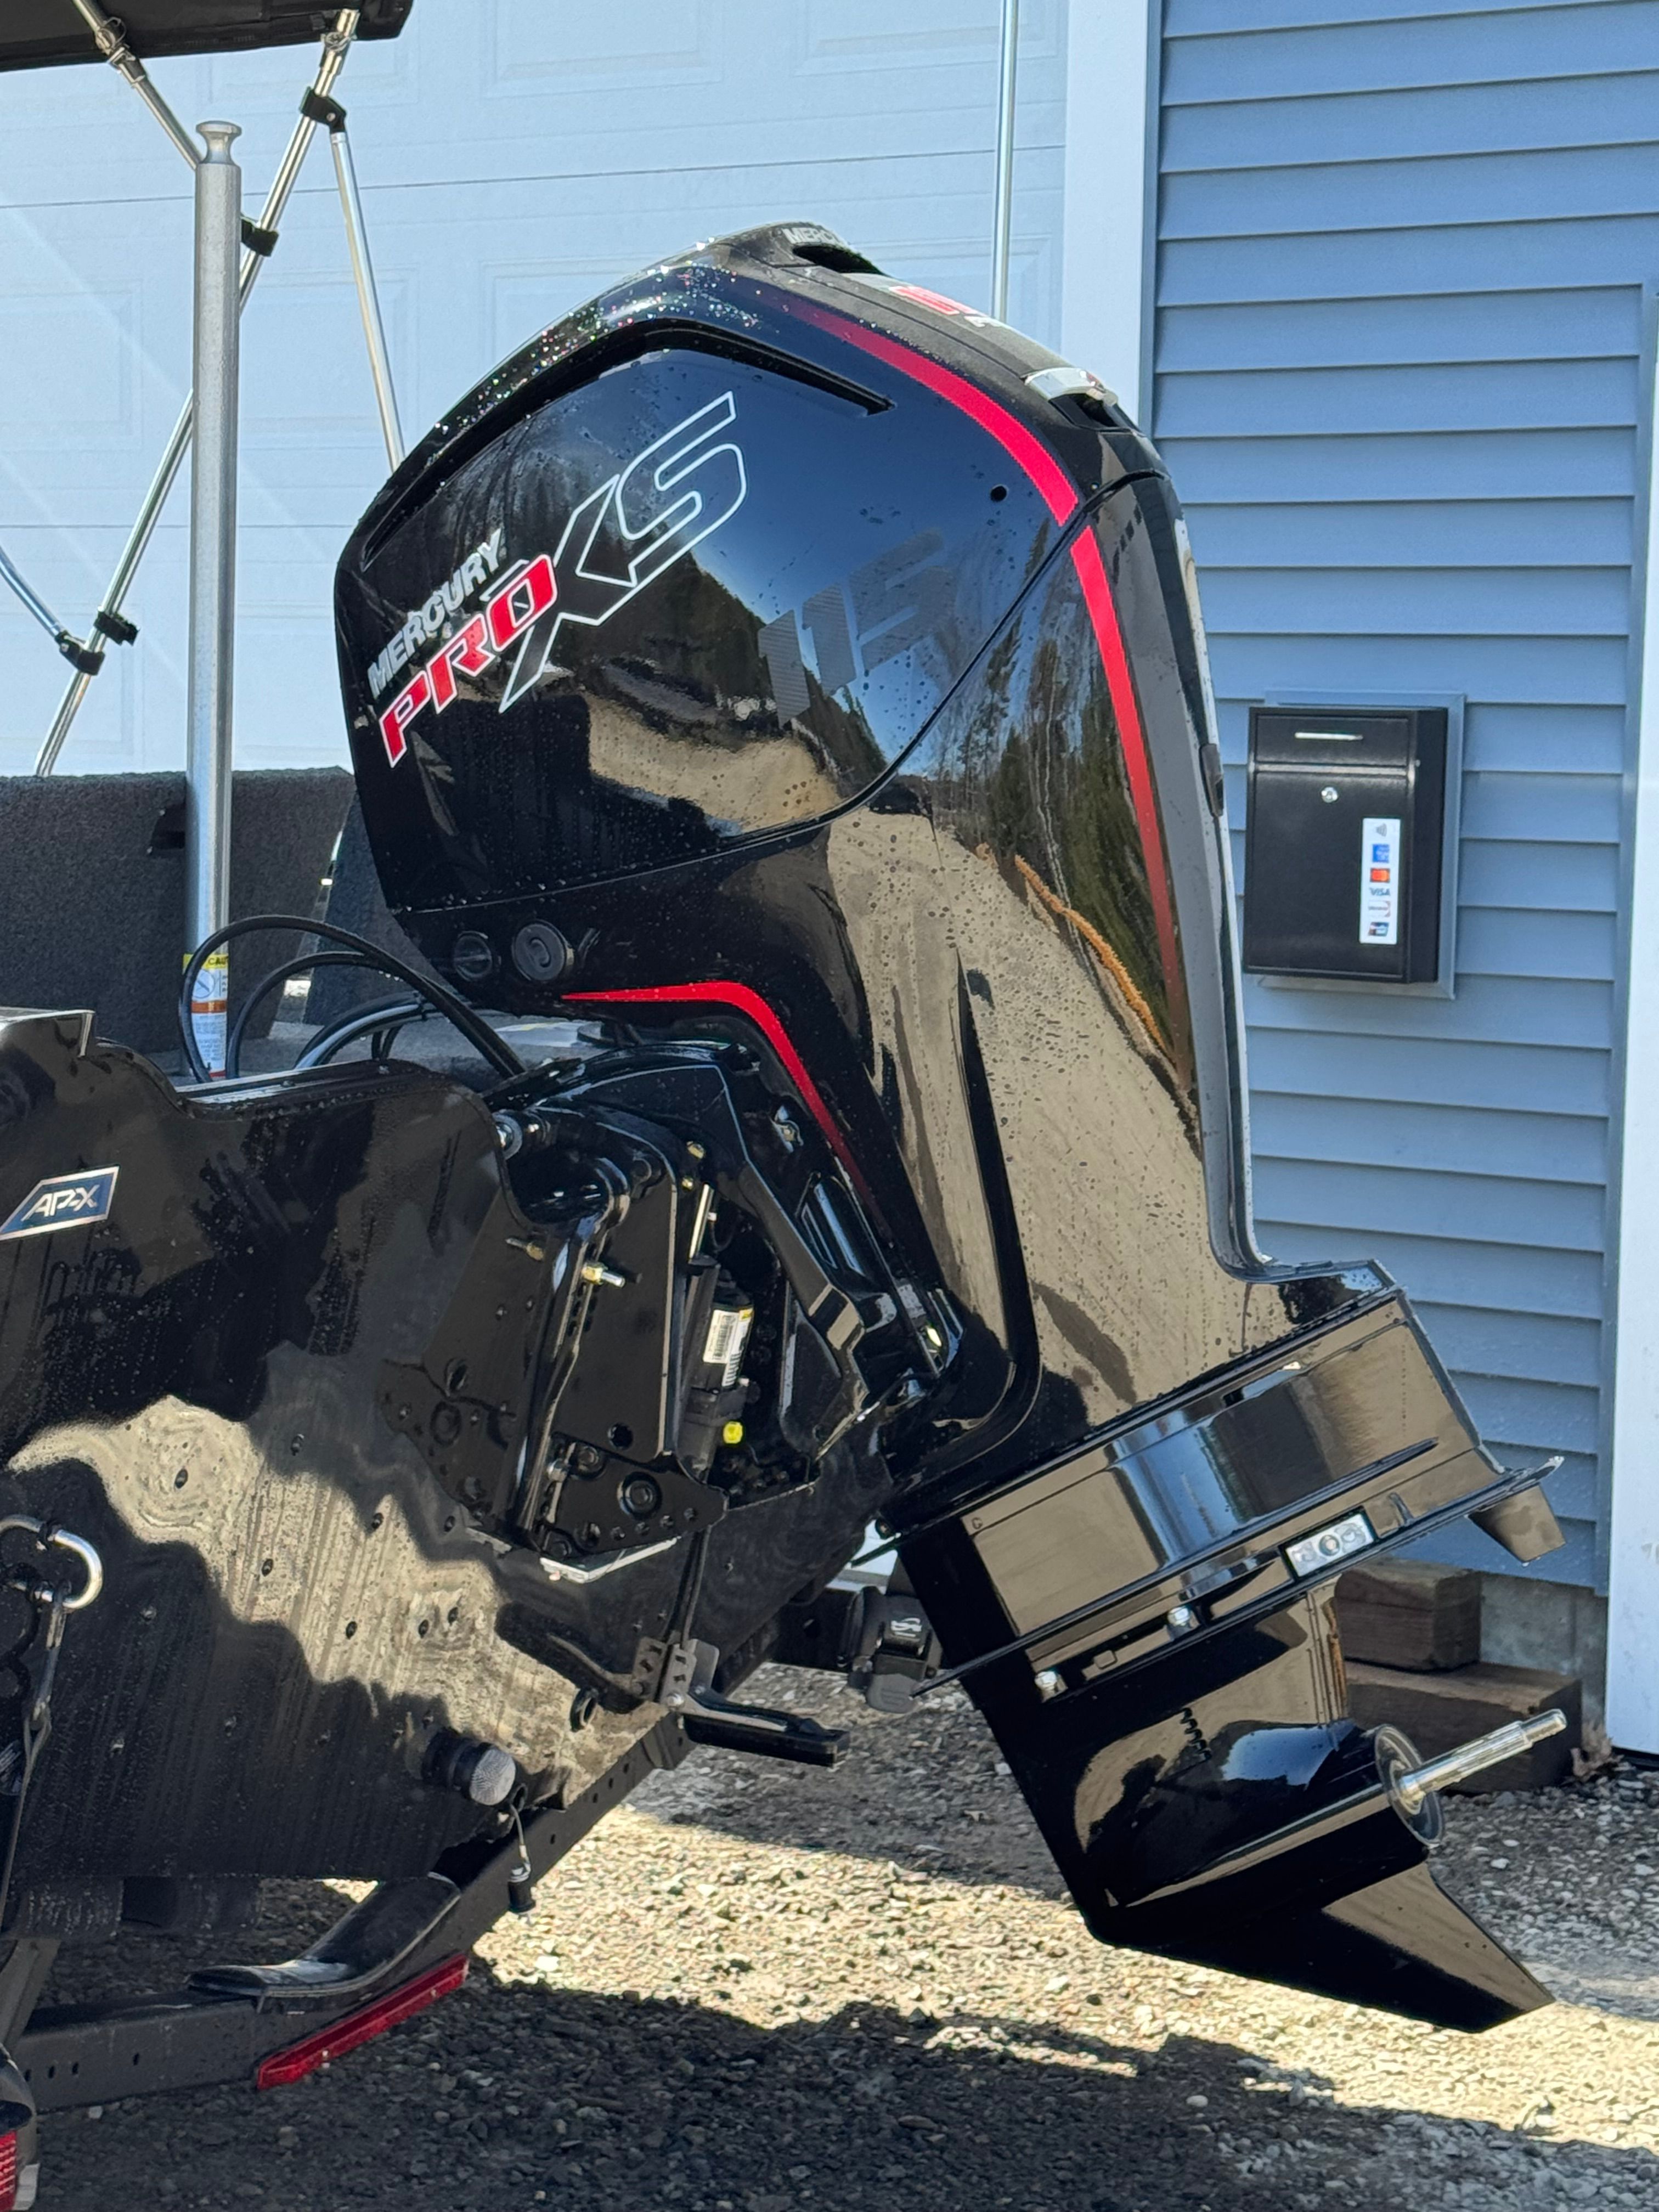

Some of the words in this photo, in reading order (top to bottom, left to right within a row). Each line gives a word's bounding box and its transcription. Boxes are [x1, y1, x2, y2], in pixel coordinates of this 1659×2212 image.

[367, 528, 501, 699] MERCURY
[379, 554, 557, 768] PRO
[481, 390, 747, 713] XS
[758, 527, 957, 727] 115
[1369, 888, 1391, 896] VISA
